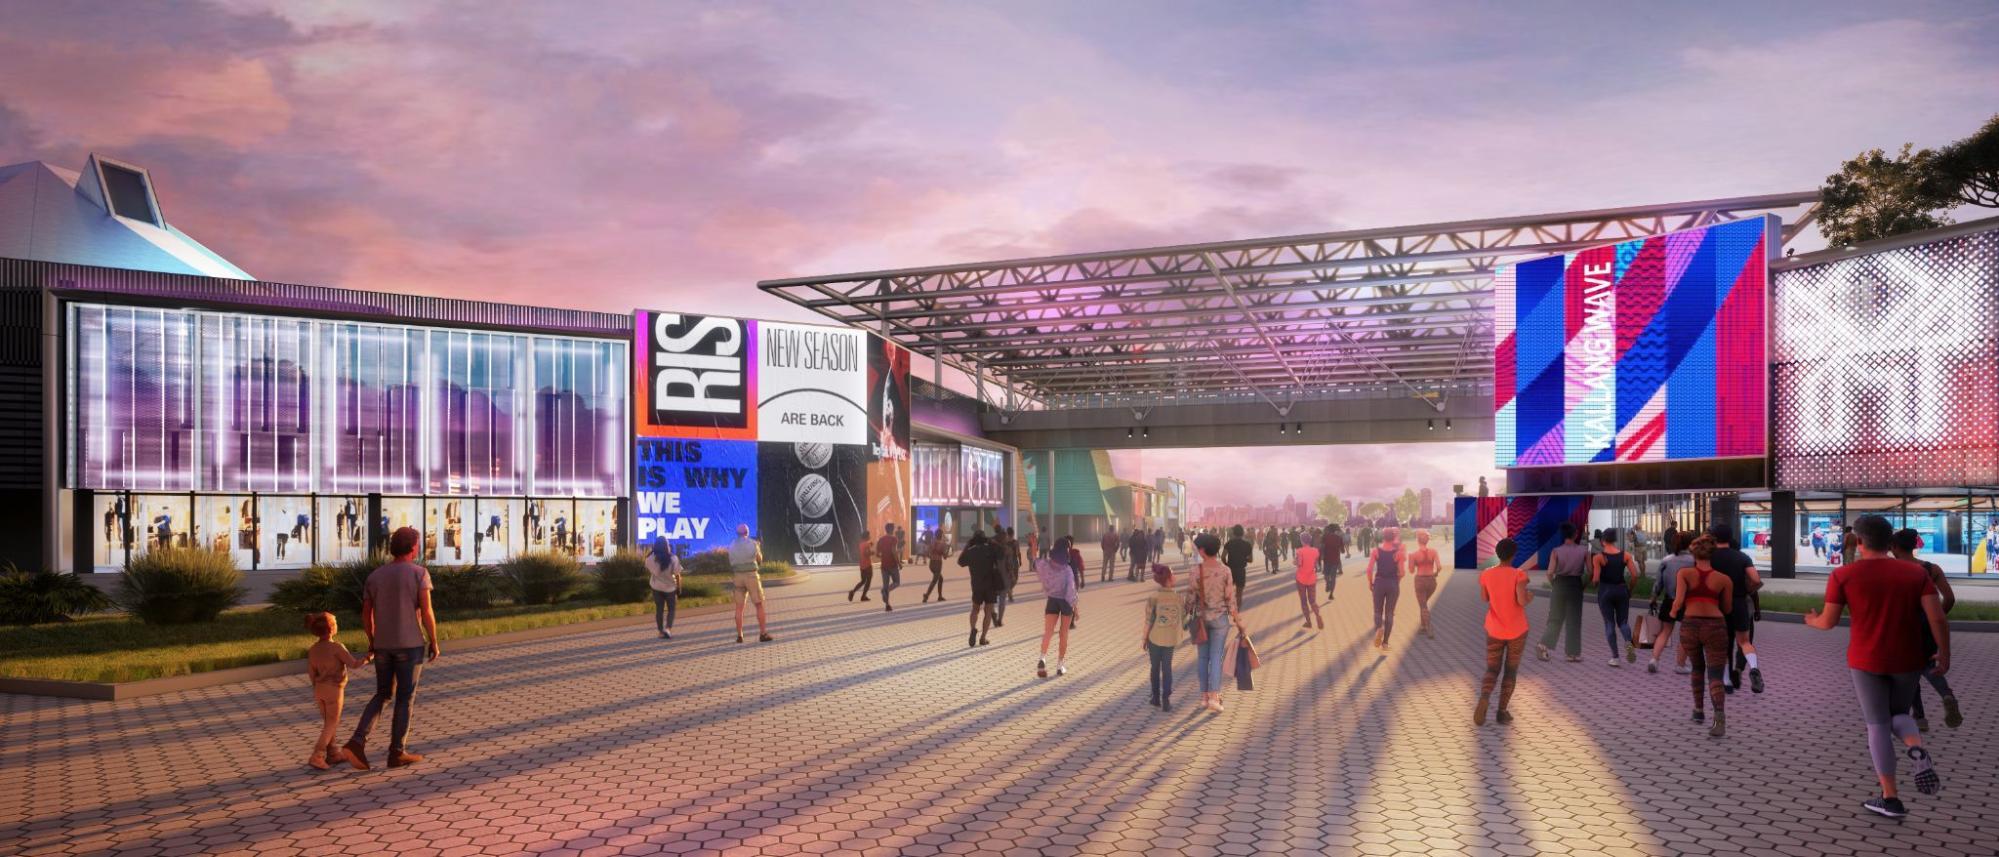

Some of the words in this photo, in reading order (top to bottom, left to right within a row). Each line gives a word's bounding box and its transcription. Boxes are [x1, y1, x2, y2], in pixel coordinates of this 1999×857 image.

[1583, 262, 1612, 333] WAVE
[766, 328, 801, 369] NEW
[804, 333, 858, 373] SEASON
[655, 313, 741, 413] RIS
[1583, 340, 1612, 450] KALLANG
[781, 412, 807, 426] ARE
[810, 414, 844, 428] BACK
[638, 440, 702, 463] THIS
[638, 466, 667, 489] IS
[683, 467, 749, 489] WHY
[637, 491, 681, 514] WE
[638, 517, 710, 540] PLAY
